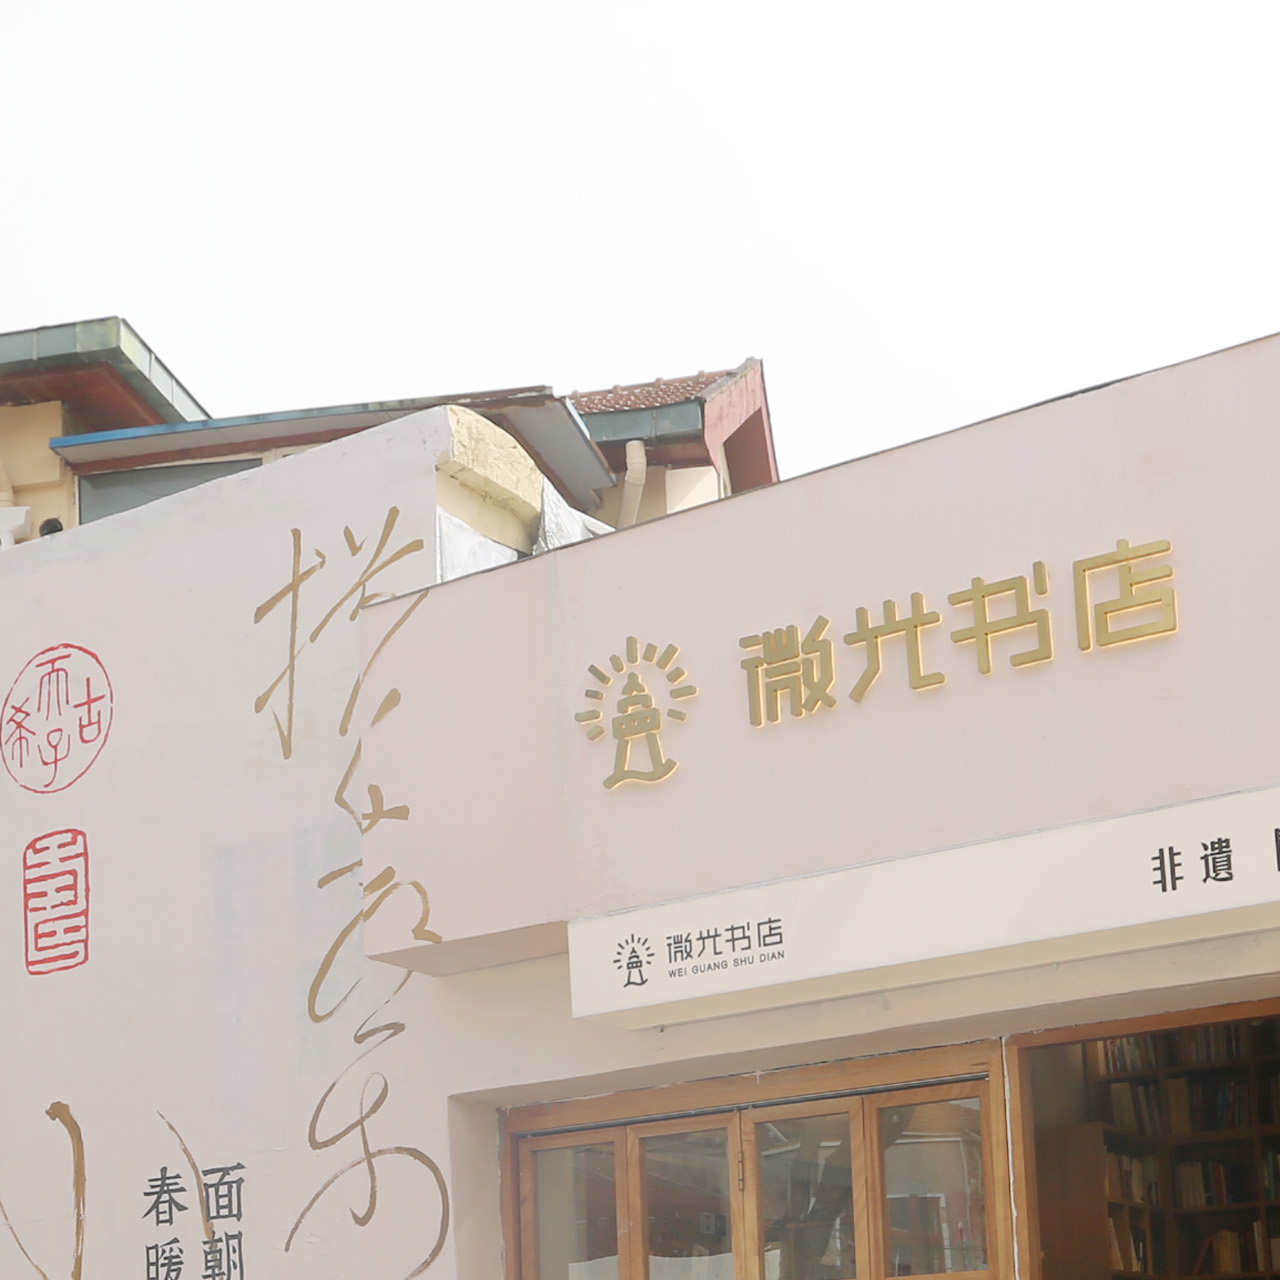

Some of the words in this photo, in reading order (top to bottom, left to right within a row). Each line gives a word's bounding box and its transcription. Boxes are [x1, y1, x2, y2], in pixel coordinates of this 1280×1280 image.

[738, 538, 1178, 729] 微光书店
[1151, 836, 1235, 893] 非遺
[666, 917, 784, 964] 微光书店
[668, 967, 688, 979] WEI
[692, 961, 729, 975] GUANG
[733, 956, 755, 968] SHU
[759, 950, 785, 963] DIAN
